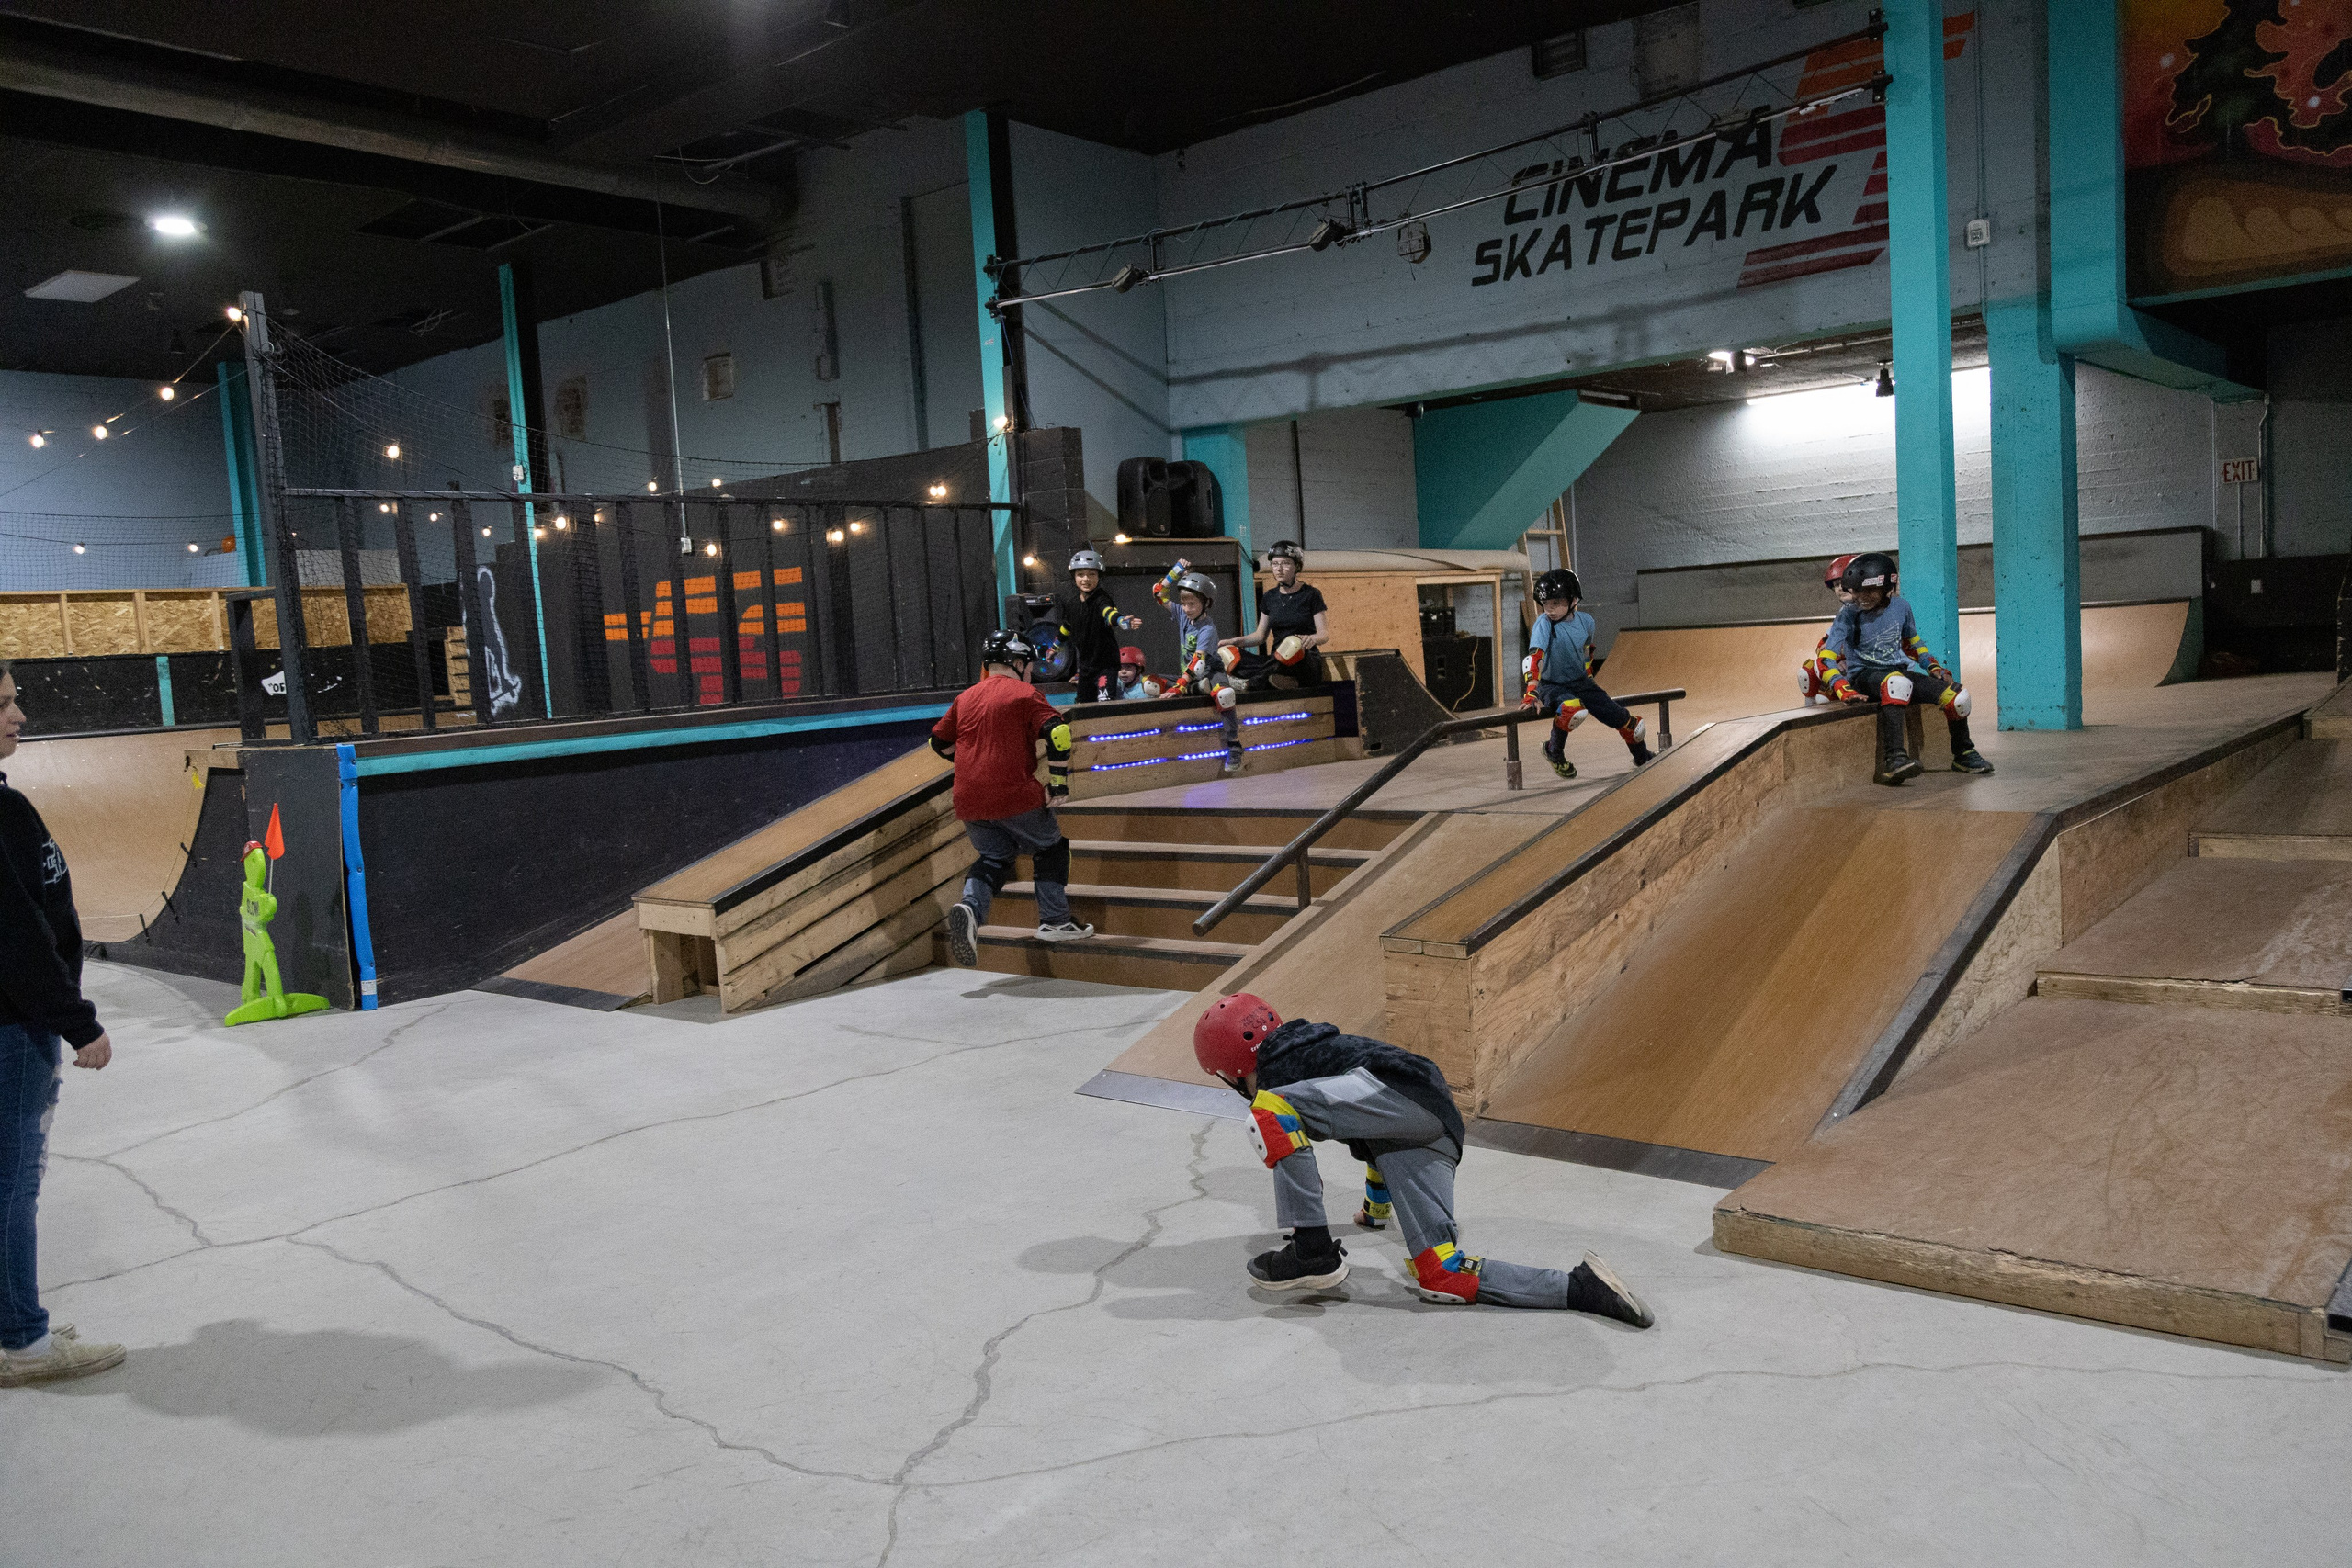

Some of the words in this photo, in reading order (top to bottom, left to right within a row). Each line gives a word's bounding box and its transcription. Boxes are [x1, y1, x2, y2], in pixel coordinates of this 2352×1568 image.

[1503, 104, 1772, 225] CINEMA
[1471, 164, 1838, 287] SKATEPARK
[2222, 459, 2255, 483] EXIT
